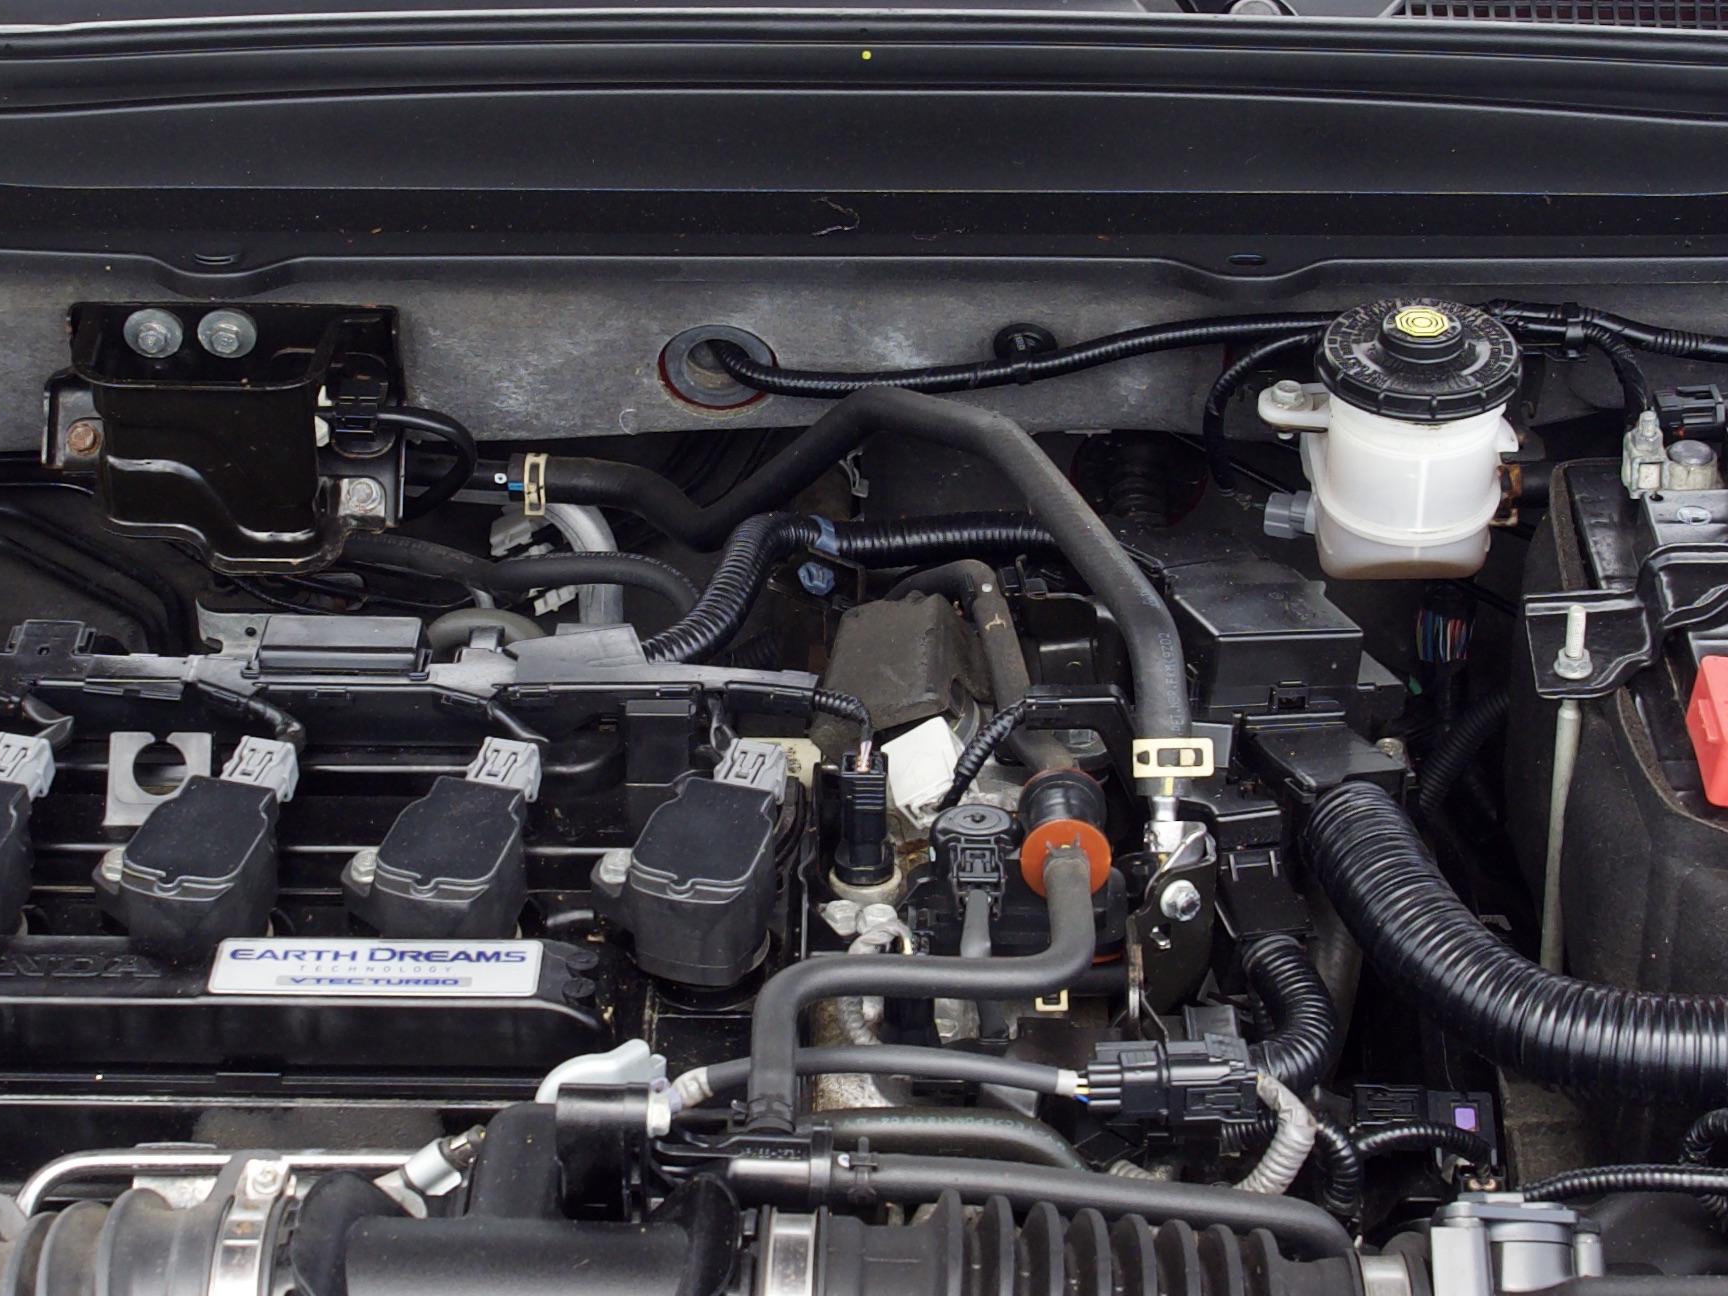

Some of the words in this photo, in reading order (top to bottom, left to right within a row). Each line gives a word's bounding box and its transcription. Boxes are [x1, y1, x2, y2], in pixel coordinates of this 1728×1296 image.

[229, 948, 358, 962] EARTH
[368, 947, 527, 963] DREAMS
[299, 964, 453, 973] TECHNOLOGY
